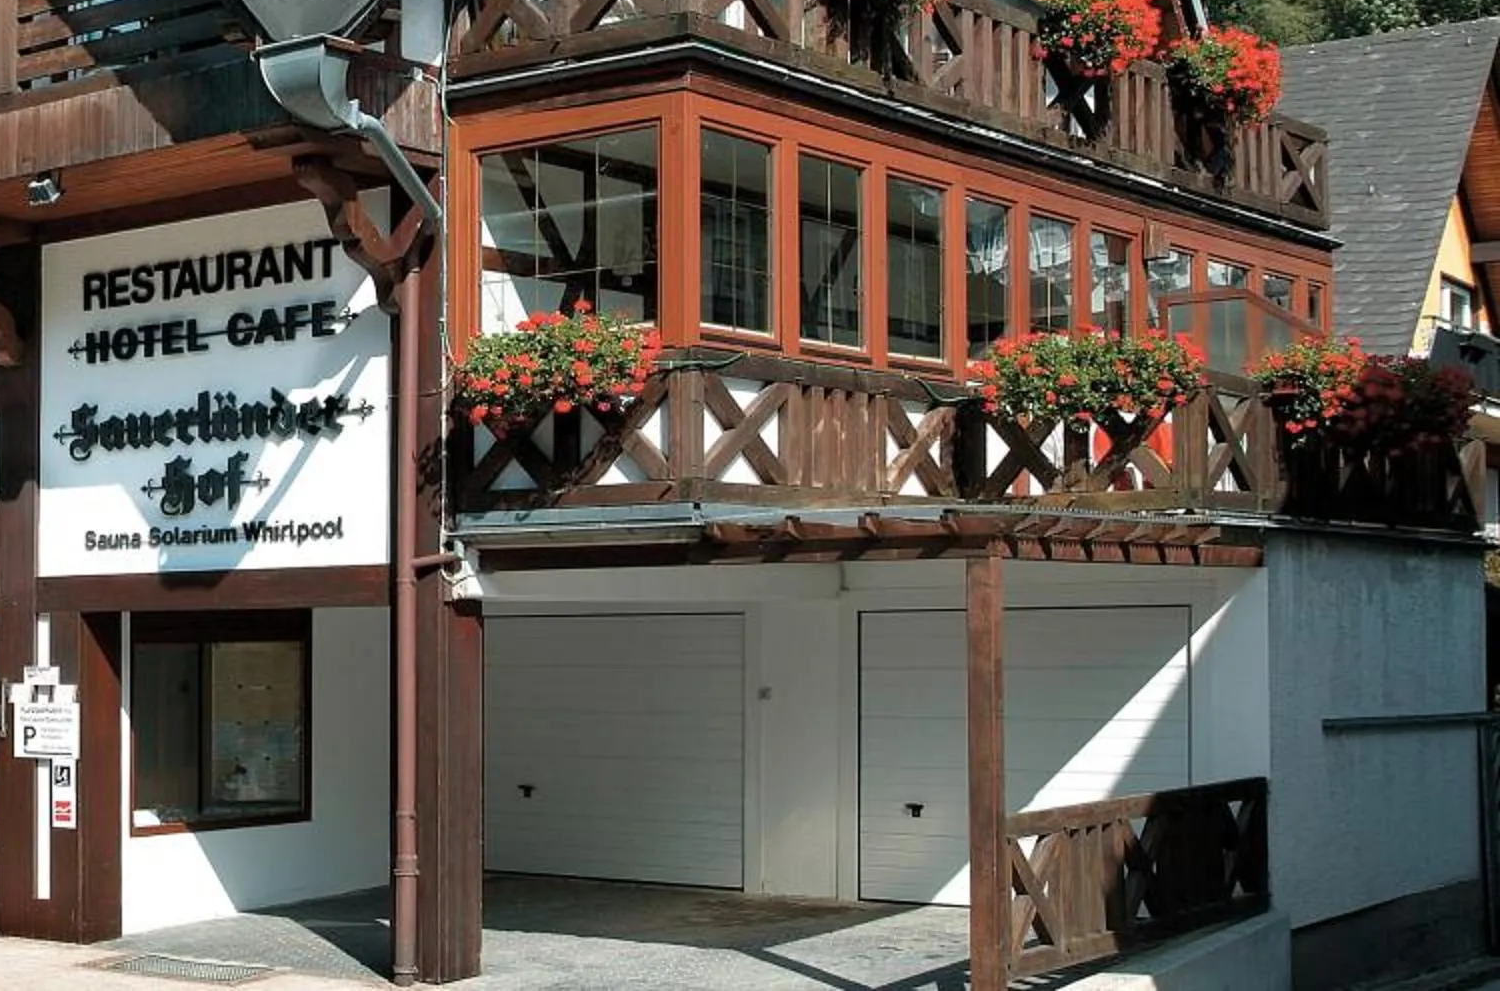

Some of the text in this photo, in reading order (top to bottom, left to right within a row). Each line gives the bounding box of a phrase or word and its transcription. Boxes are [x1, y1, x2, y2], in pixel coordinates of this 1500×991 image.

[83, 238, 342, 311] RESTAURANT
[85, 300, 338, 364] HOTEL CAFE
[69, 387, 349, 461] Sauerländer
[160, 450, 250, 516] Hof
[85, 517, 344, 551] Sauna Solarium Whirlpool
[23, 725, 37, 747] P
